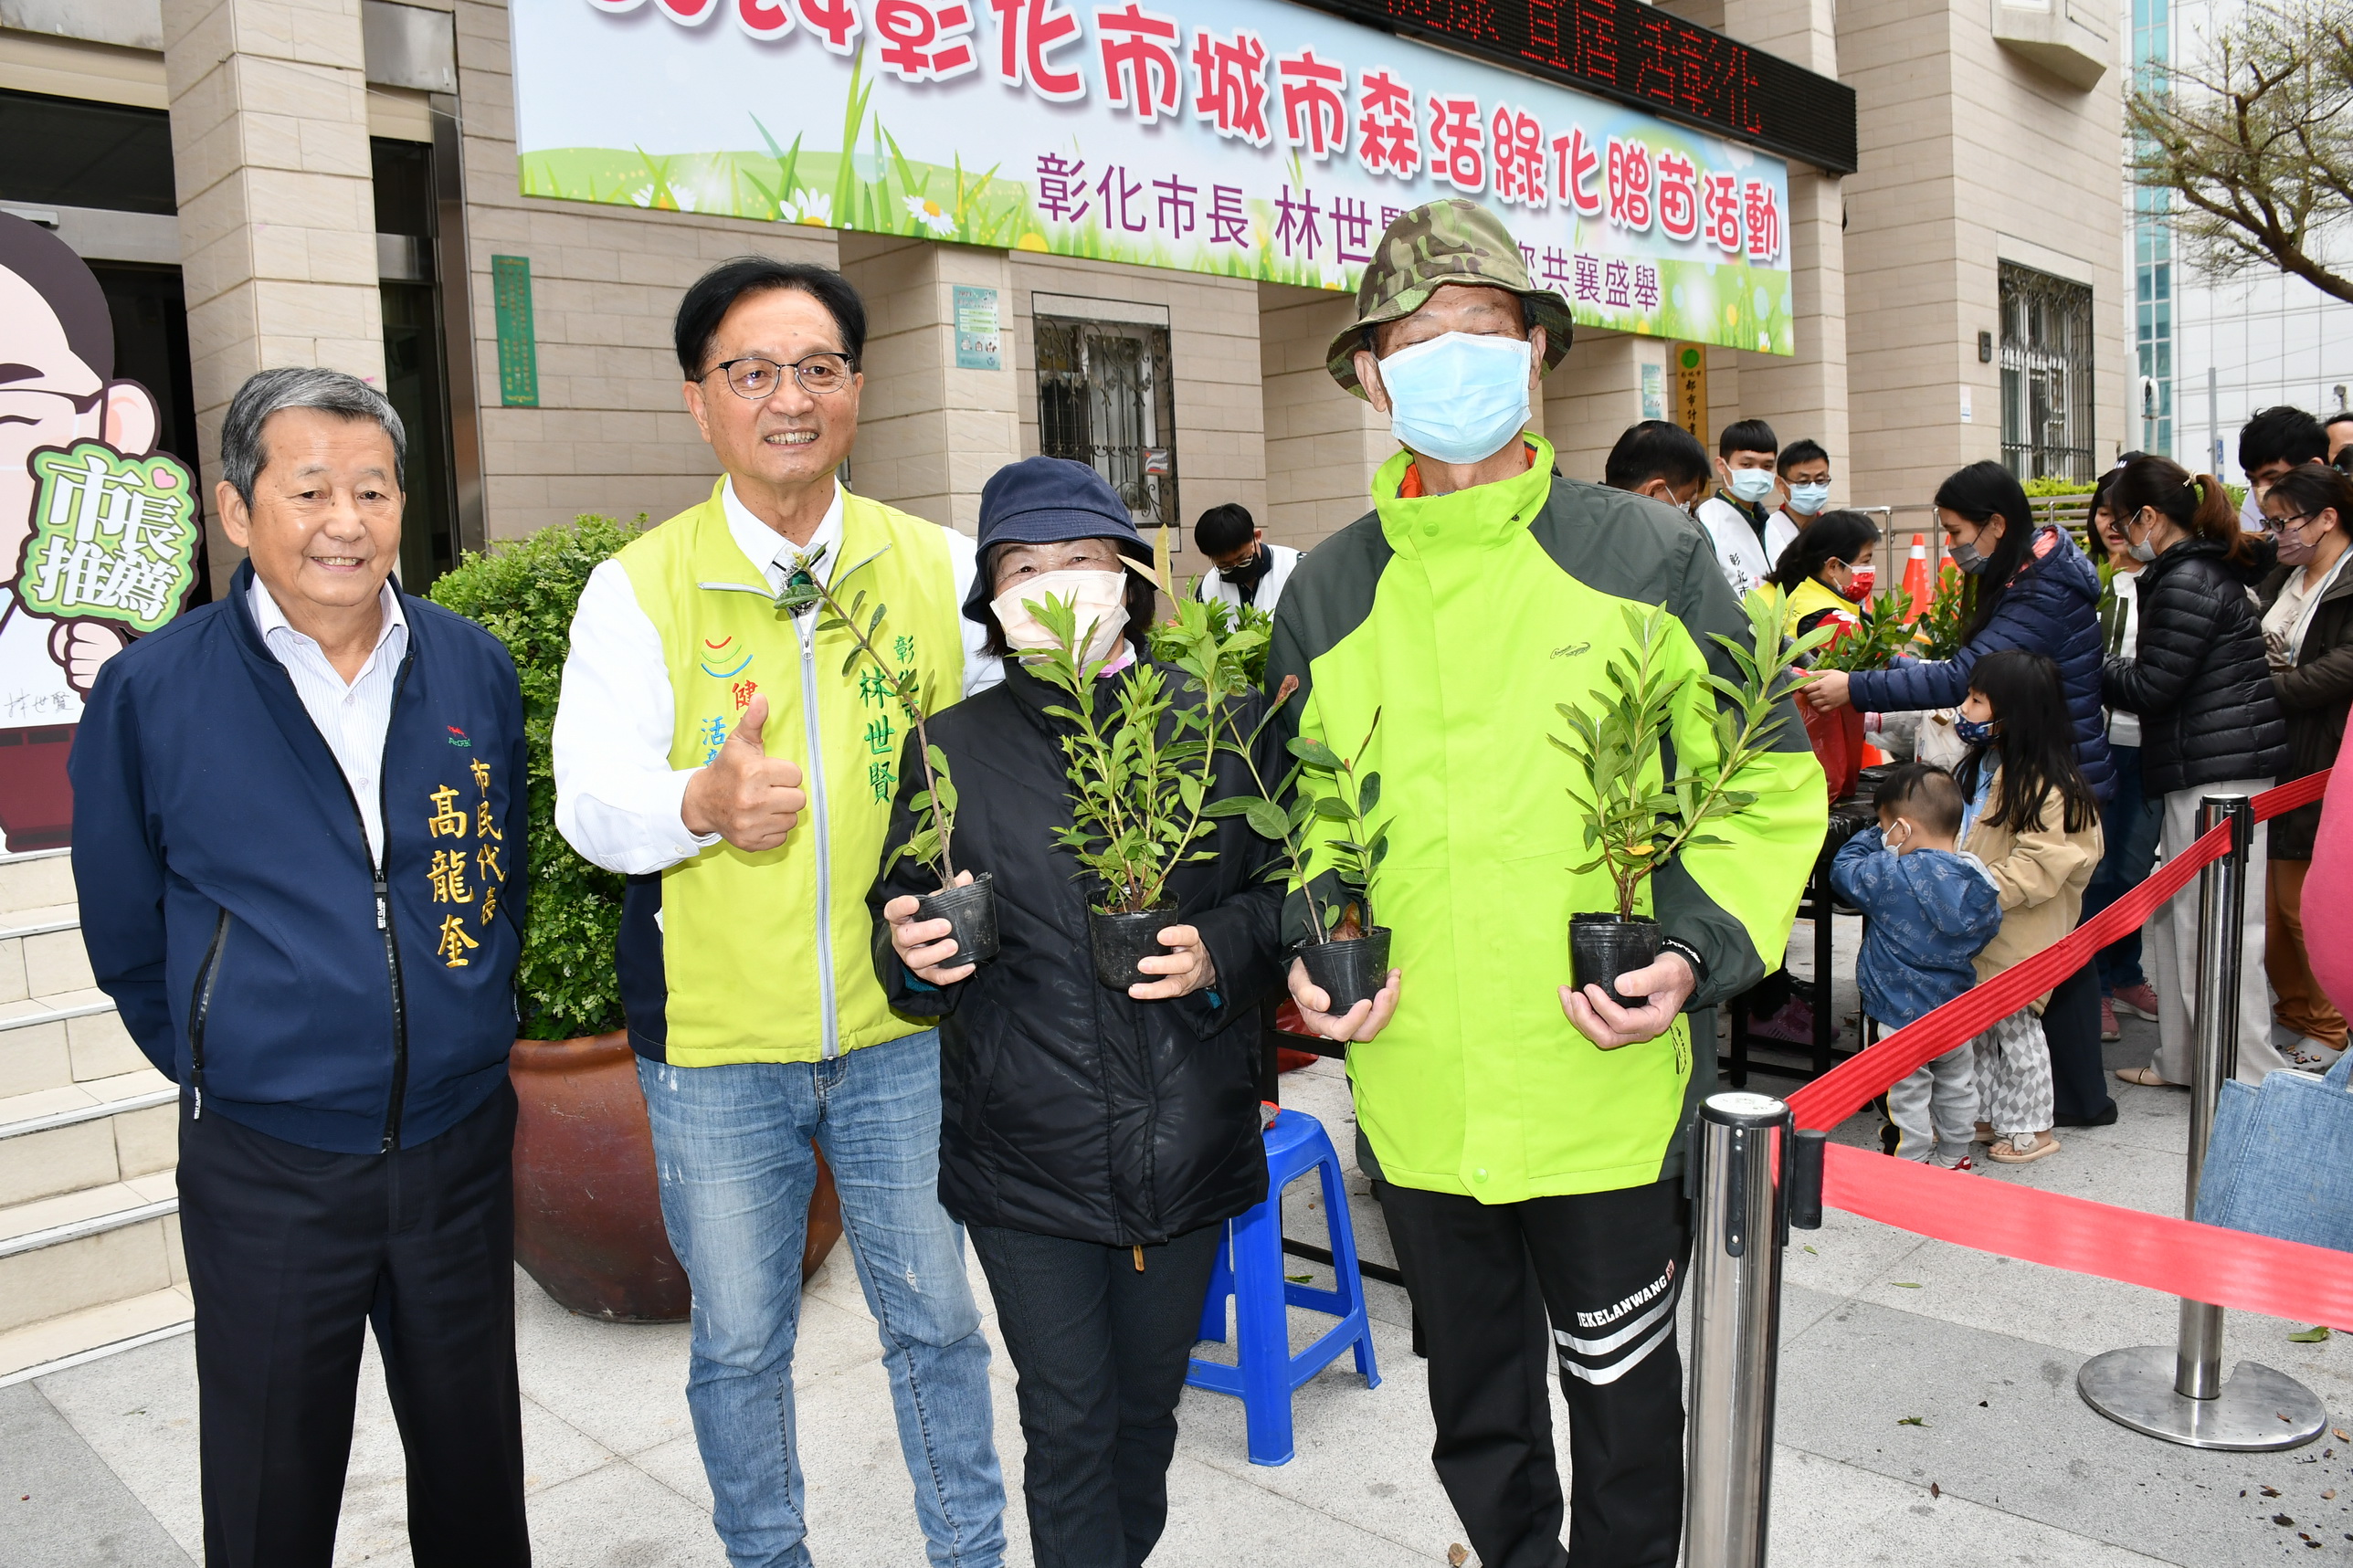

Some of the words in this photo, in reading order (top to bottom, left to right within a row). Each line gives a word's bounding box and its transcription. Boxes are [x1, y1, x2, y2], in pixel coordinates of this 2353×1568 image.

[589, 0, 1779, 258] 4彰化市城市森活綠化贈苗活動
[1037, 152, 1250, 249] 彰化市長
[1274, 184, 1408, 266] 林世
[46, 454, 186, 562] 市長
[30, 534, 183, 622] 推薦
[859, 666, 898, 806] 林世賢
[470, 757, 506, 927] 市民代表
